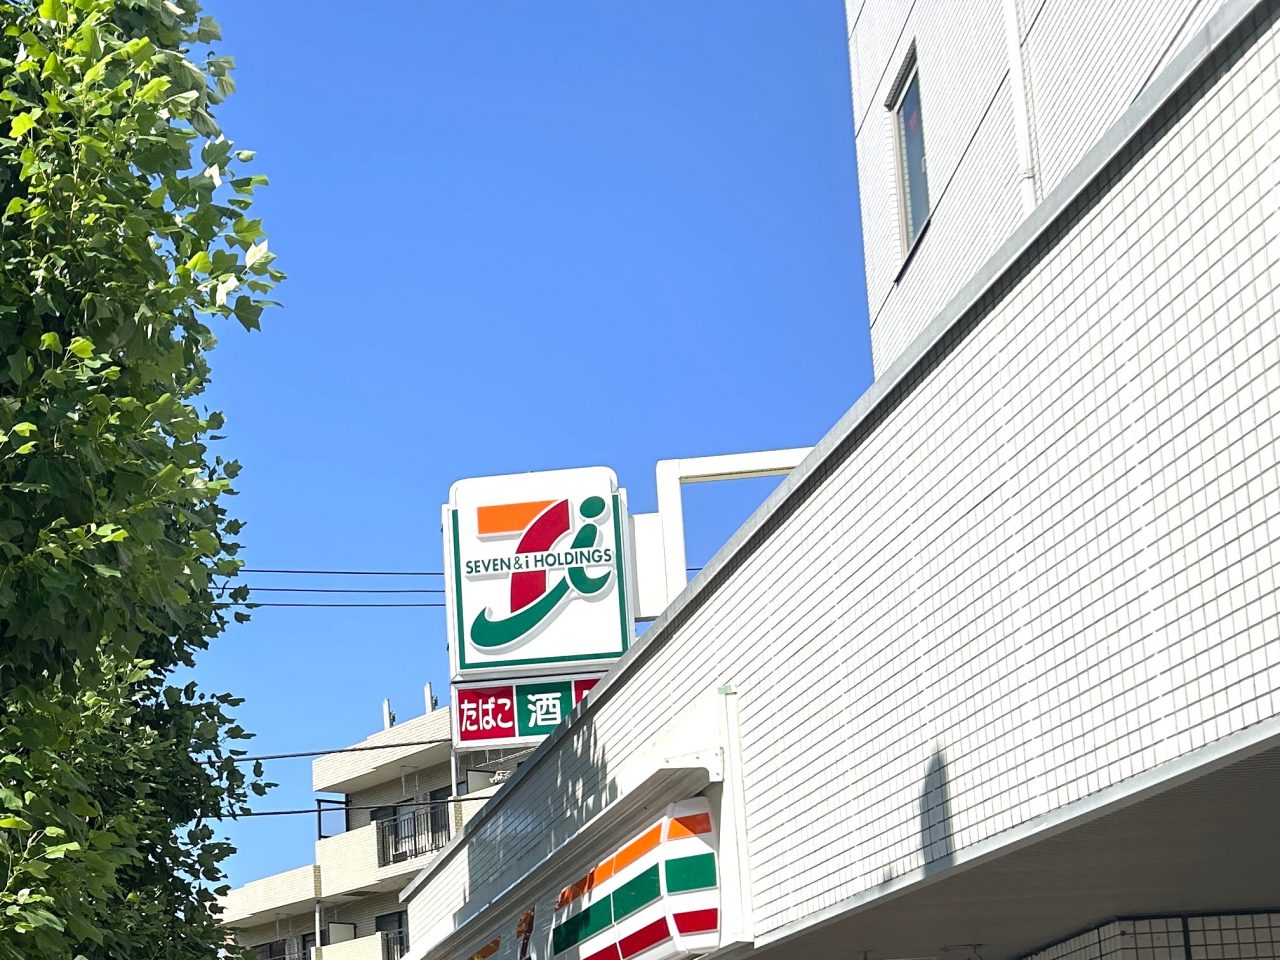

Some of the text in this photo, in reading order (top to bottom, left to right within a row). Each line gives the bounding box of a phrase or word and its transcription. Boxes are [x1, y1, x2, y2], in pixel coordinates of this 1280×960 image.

[534, 548, 612, 568] HOLDINGS
[461, 697, 513, 731] たばこ
[528, 692, 562, 727] 酒
